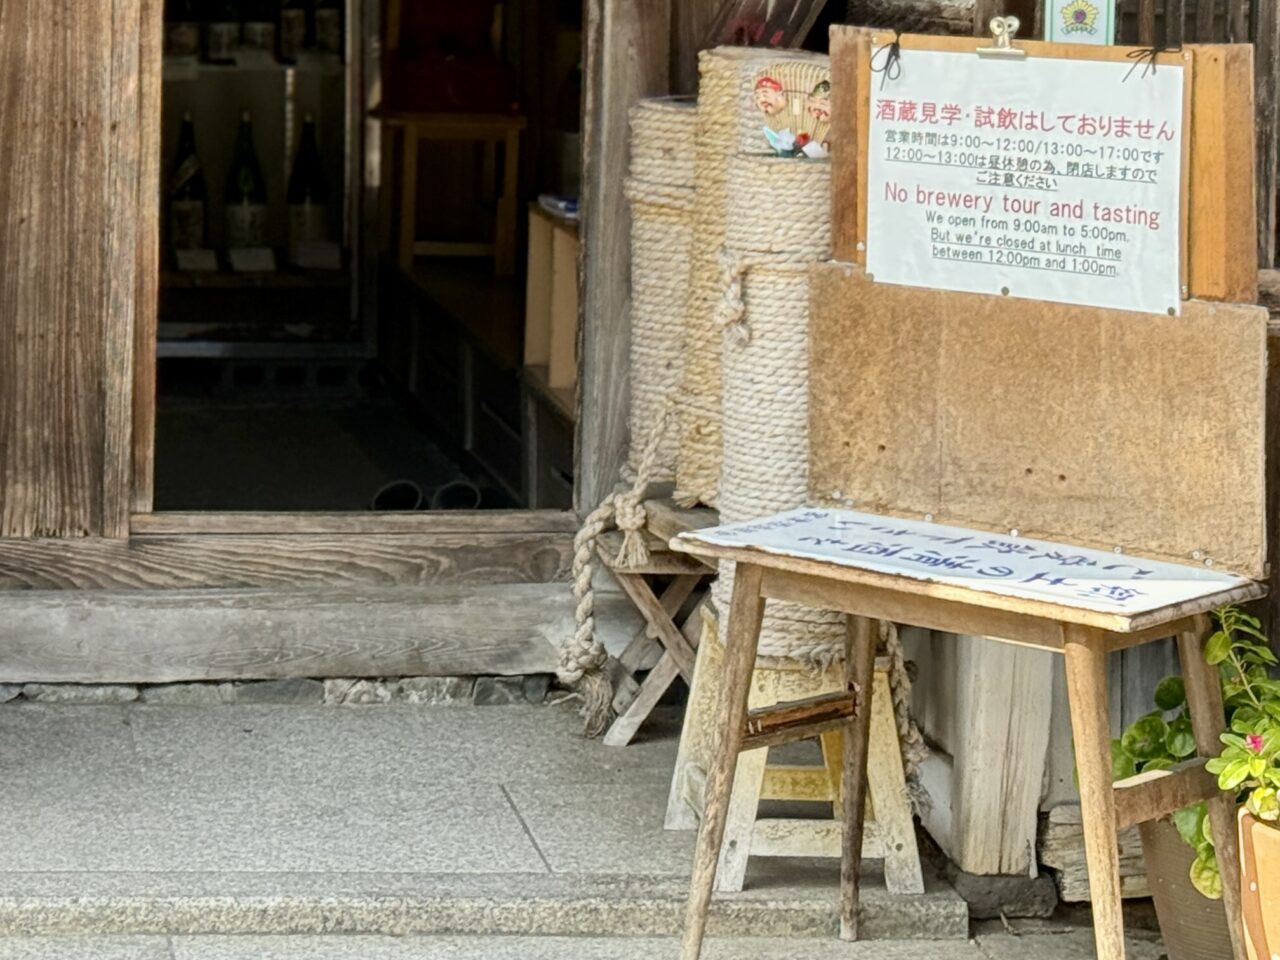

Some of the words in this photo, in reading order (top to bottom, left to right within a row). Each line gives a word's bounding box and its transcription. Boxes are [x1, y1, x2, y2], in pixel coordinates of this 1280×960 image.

[875, 99, 1175, 141] 酒蔵見学・試飲はしておりません
[976, 170, 1057, 189] ご注意ください
[884, 182, 908, 202] No
[916, 184, 993, 213] brewery
[1003, 194, 1040, 215] tour
[1050, 199, 1084, 219] and
[1093, 202, 1160, 230] tasting
[926, 210, 943, 223] We
[948, 214, 976, 228] open
[981, 215, 1008, 230] from
[1063, 224, 1075, 237] to
[931, 227, 950, 242] But
[996, 234, 1035, 250] closed
[1039, 239, 1051, 251] at
[1056, 240, 1087, 256] lunch
[1096, 243, 1122, 259] time
[932, 244, 983, 261] between
[1045, 256, 1066, 270] and
